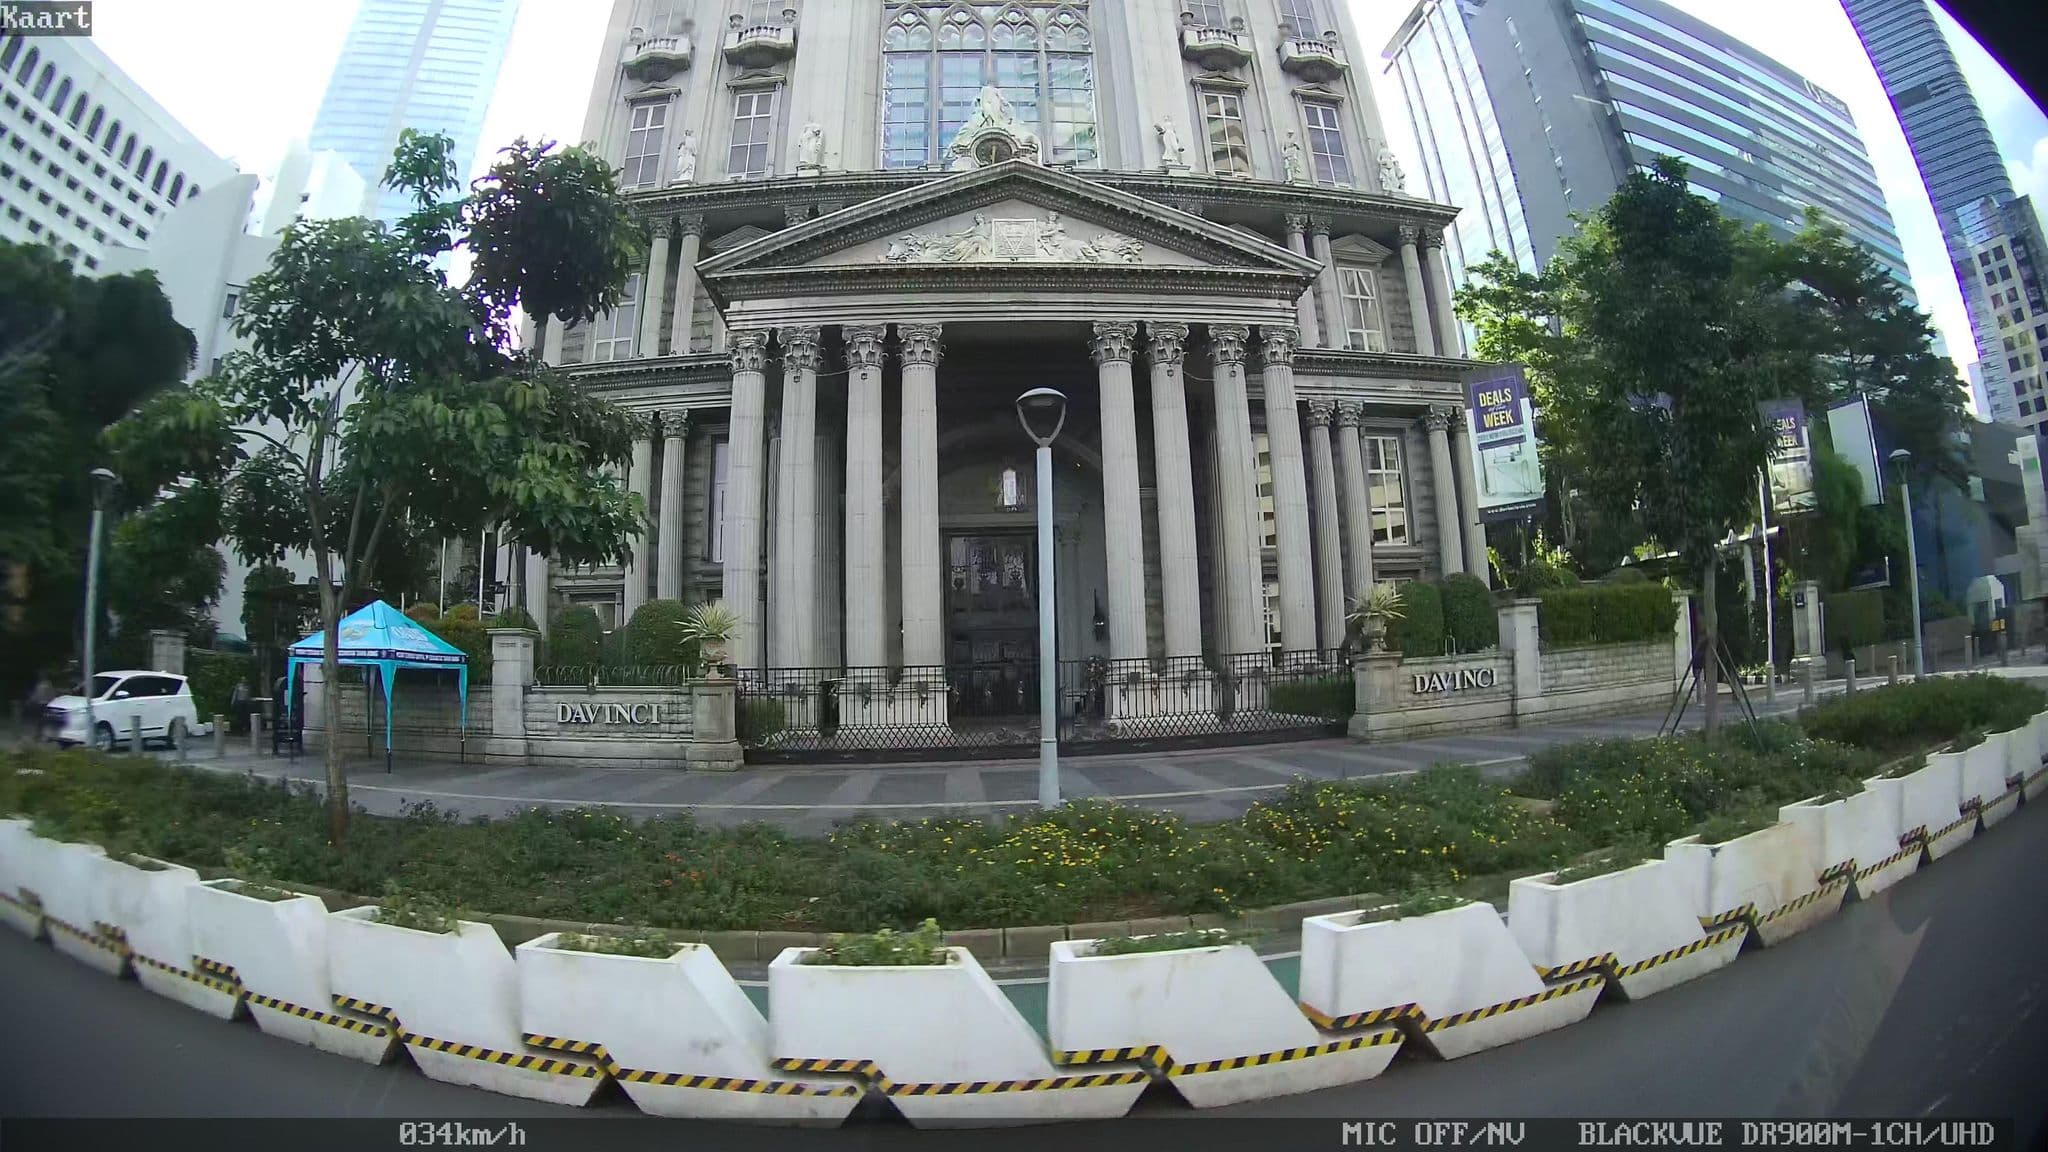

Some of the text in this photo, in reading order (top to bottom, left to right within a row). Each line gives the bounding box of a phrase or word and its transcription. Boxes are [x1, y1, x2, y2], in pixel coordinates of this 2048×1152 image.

[1479, 388, 1512, 407] DEALS
[1483, 409, 1514, 428] WEEK
[1413, 668, 1498, 694] DAVINCI
[556, 702, 661, 725] DAVINCI
